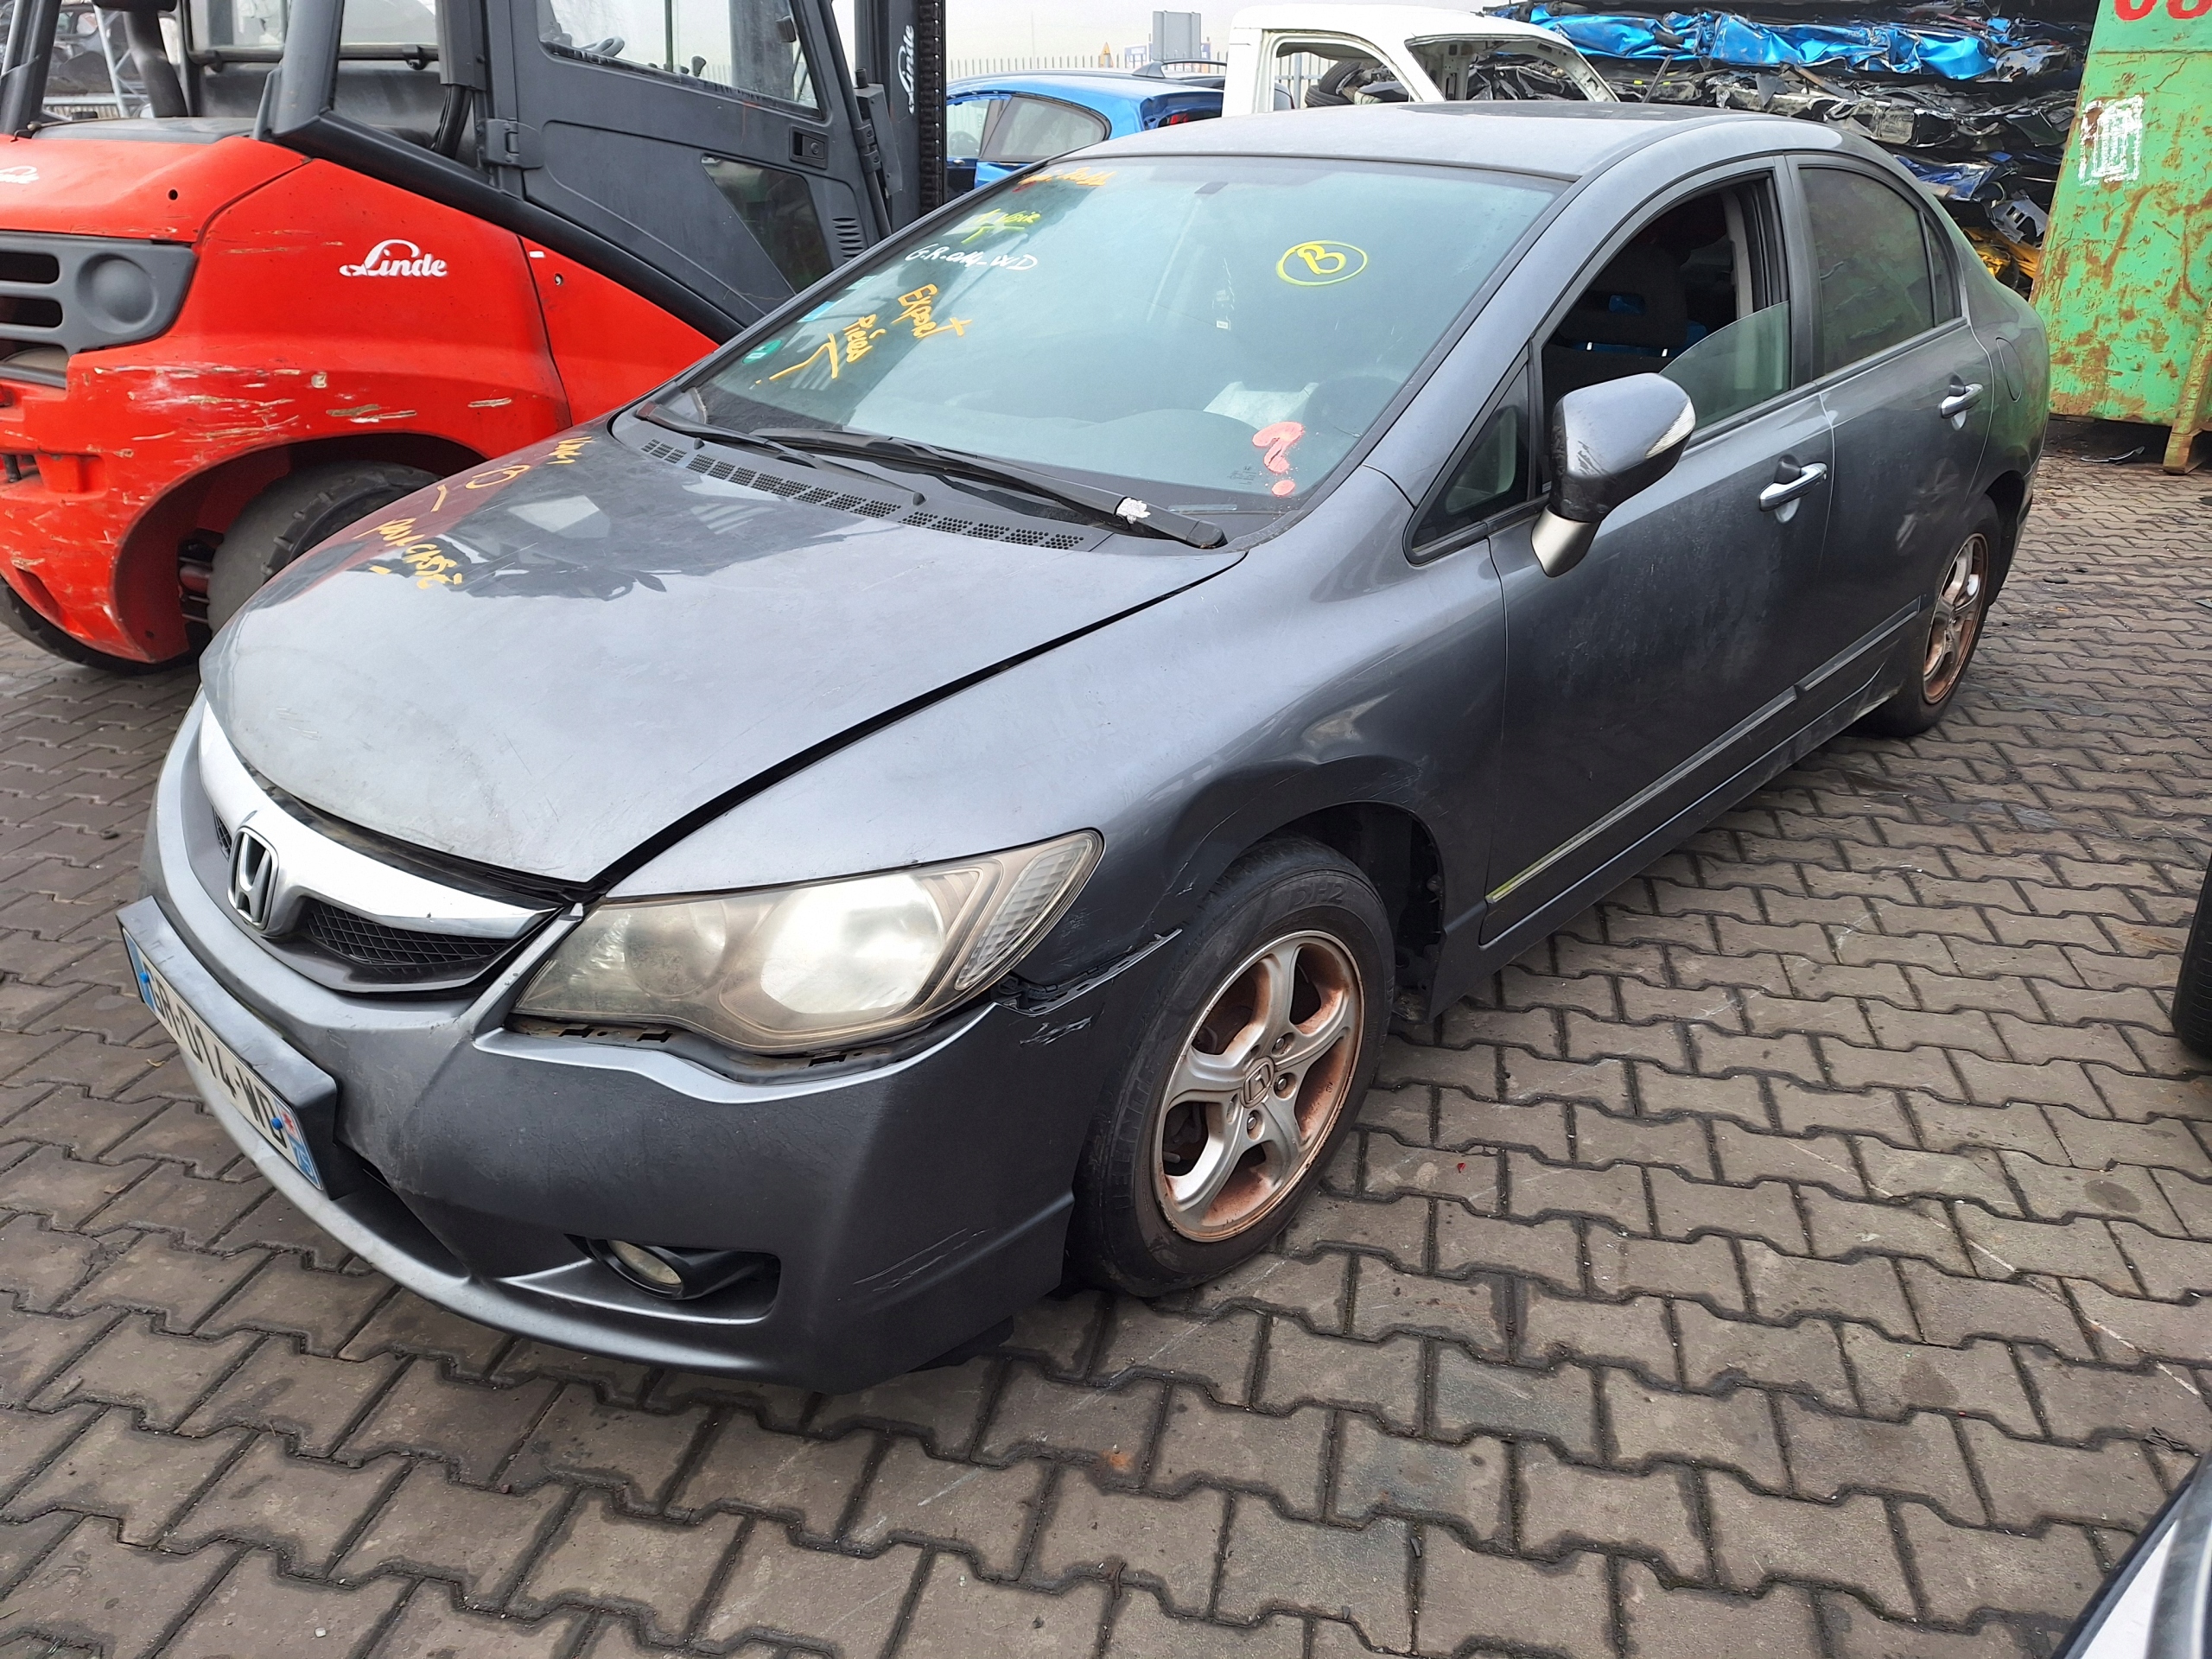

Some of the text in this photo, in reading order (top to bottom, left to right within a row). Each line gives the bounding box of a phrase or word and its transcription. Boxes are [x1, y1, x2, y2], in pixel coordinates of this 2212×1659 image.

[898, 24, 915, 114] Linde
[339, 238, 448, 276] Linde
[1297, 245, 1346, 275] B
